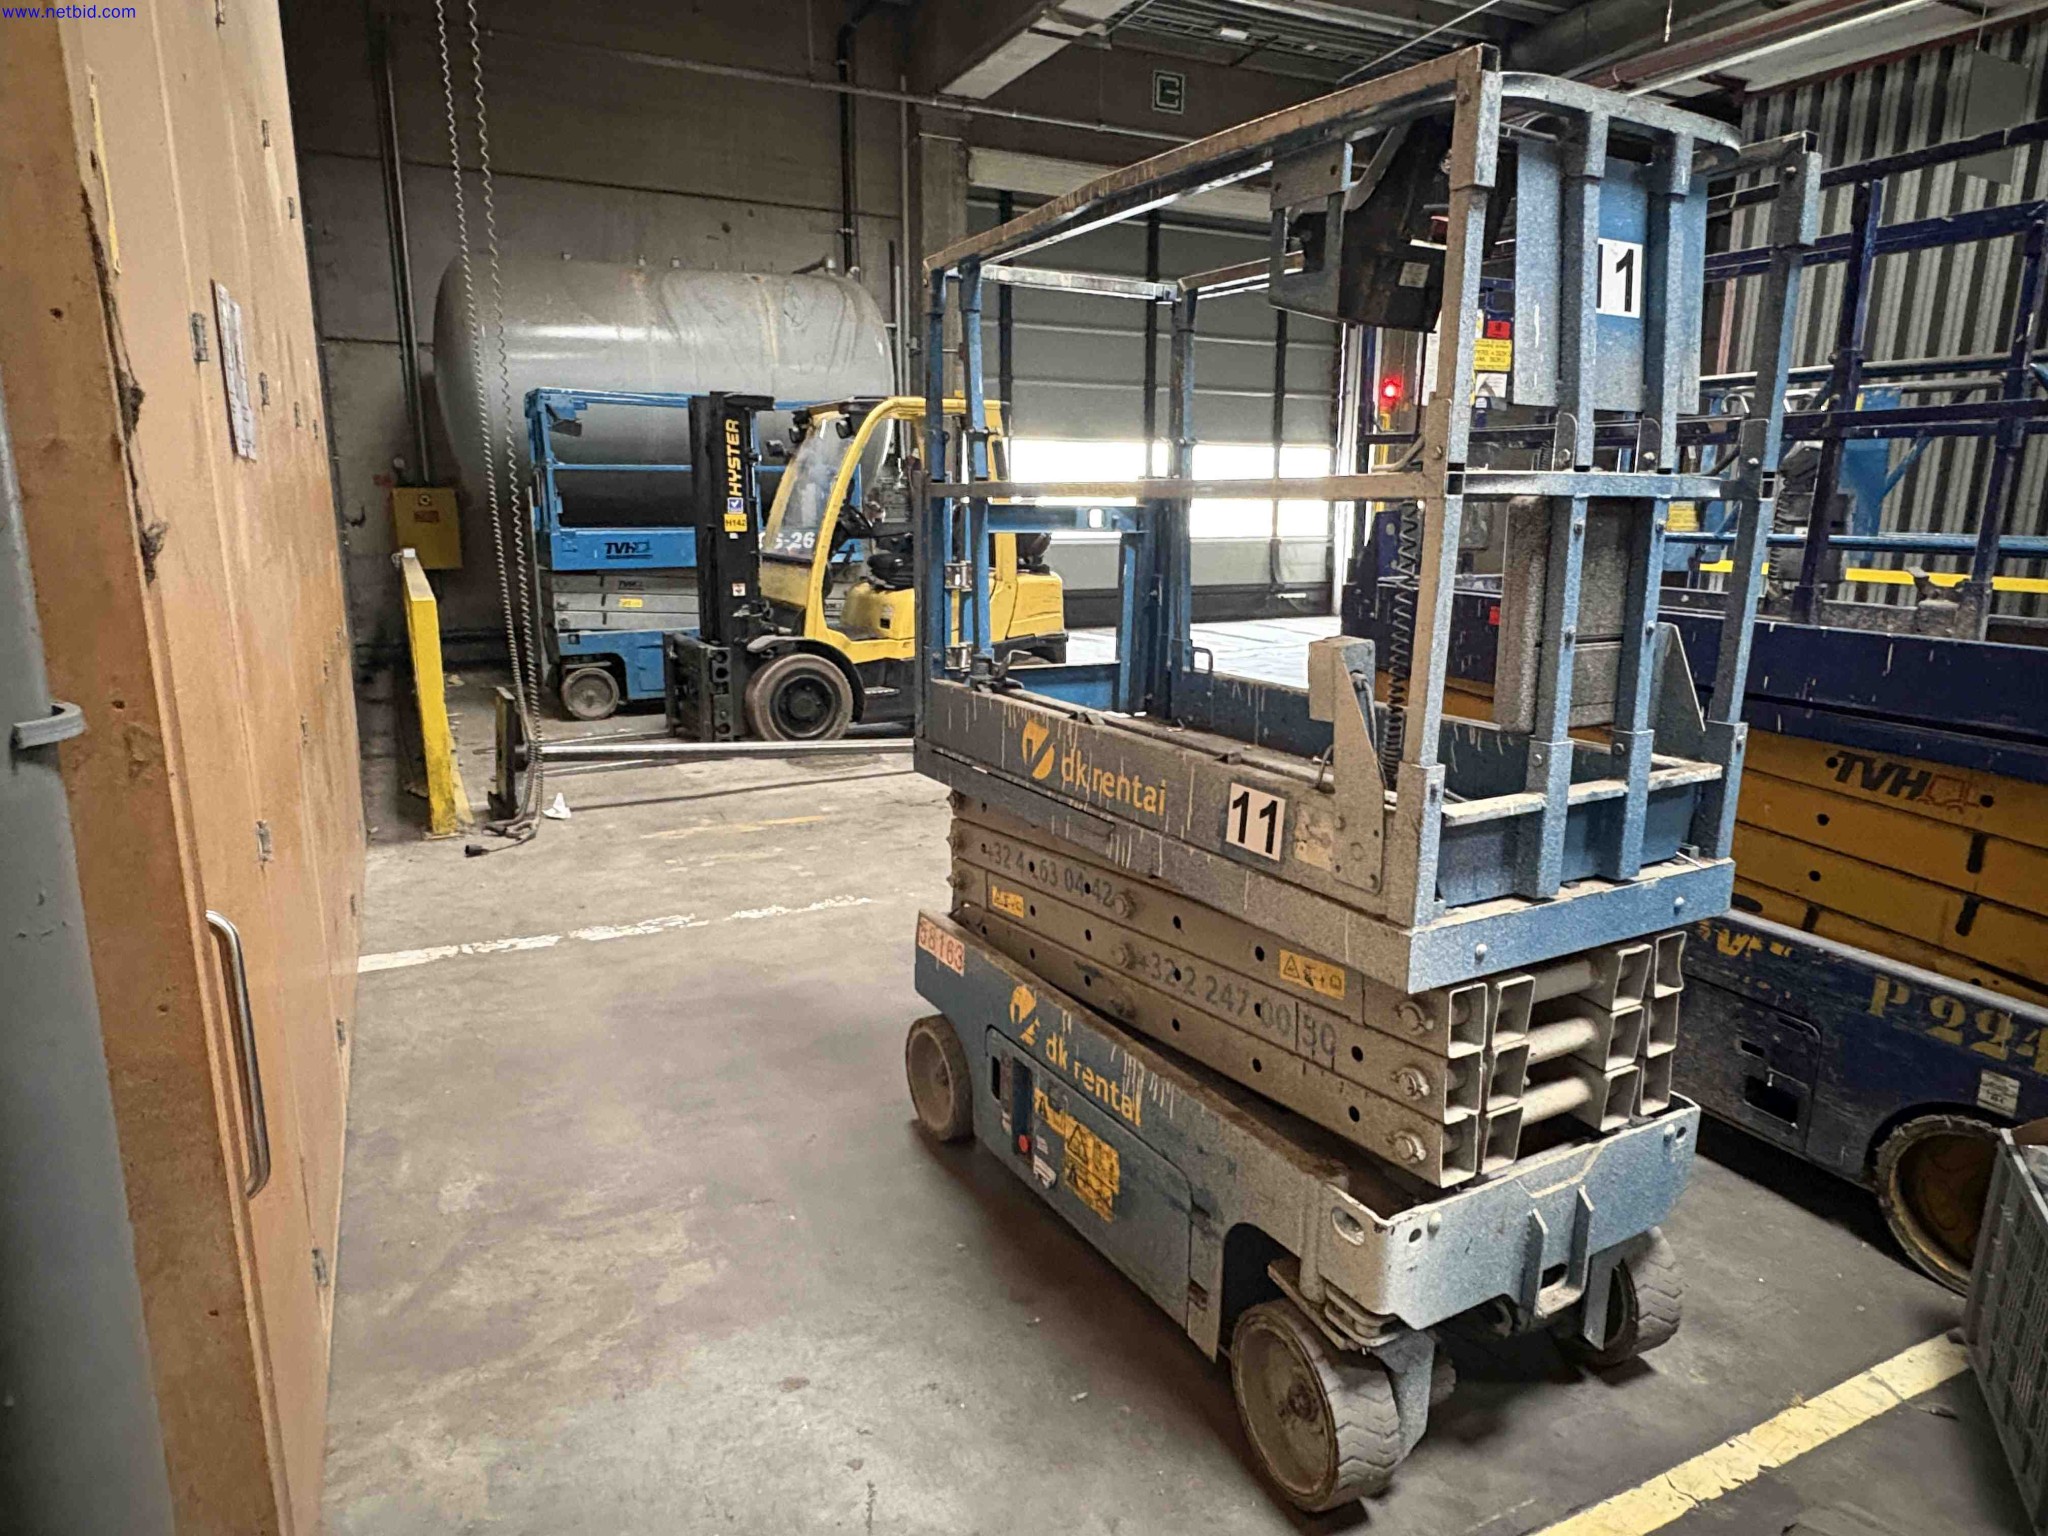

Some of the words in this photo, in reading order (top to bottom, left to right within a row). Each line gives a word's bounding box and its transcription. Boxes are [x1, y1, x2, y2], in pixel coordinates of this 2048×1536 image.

[725, 419, 742, 497] HYSTER
[1836, 750, 1932, 801] TVH
[1232, 791, 1278, 854] 11
[1868, 974, 1910, 1018] P
[1045, 1031, 1068, 1071] dk
[1074, 1059, 1142, 1127] rental
